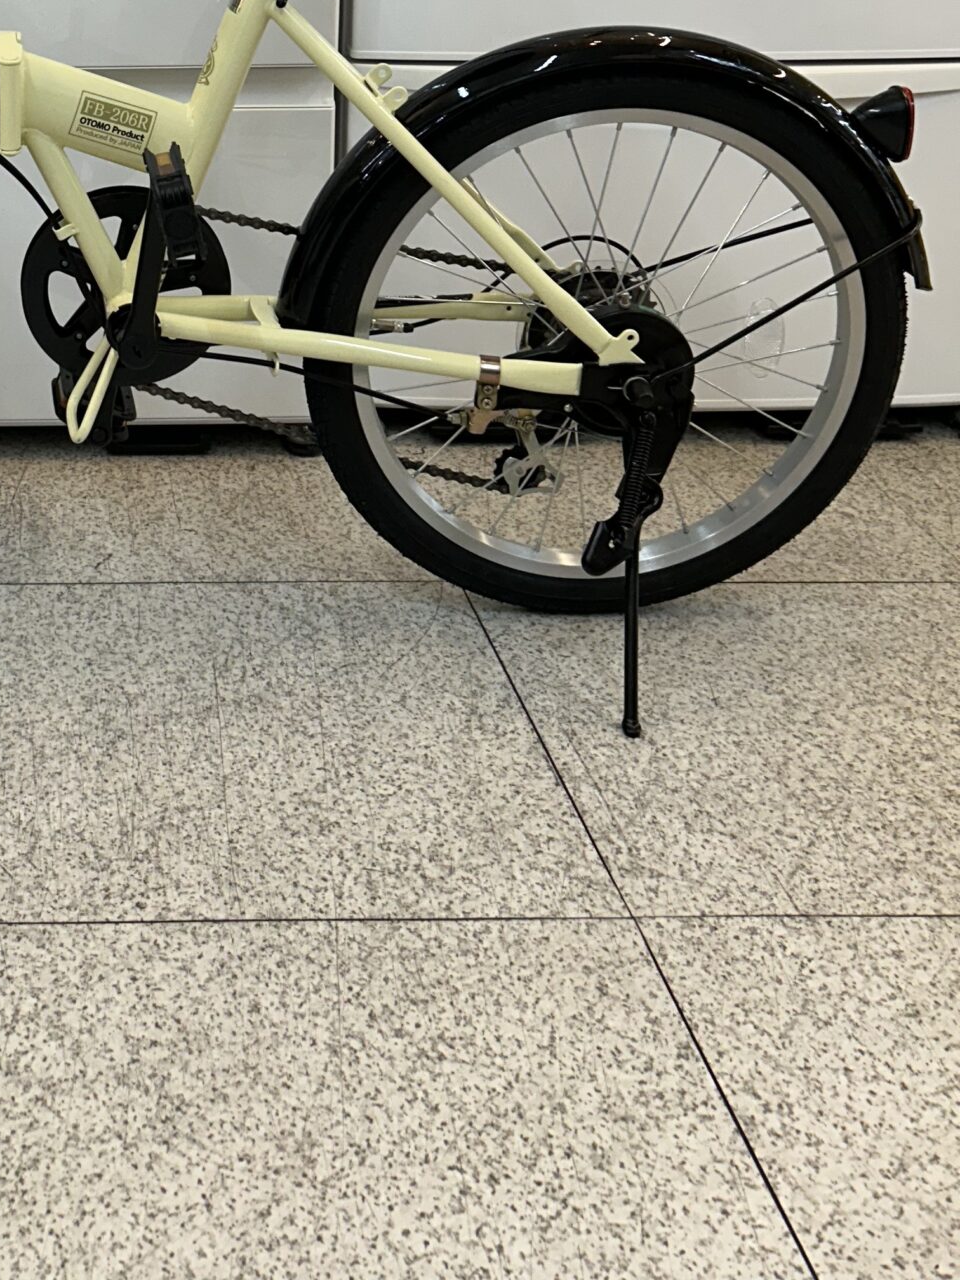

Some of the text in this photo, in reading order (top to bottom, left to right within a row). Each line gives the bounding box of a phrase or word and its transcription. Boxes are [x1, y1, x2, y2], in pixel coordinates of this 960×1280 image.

[83, 99, 149, 131] FB-206R
[76, 126, 141, 151] Produced by JAPAN
[79, 116, 145, 142] OTOMO Product
